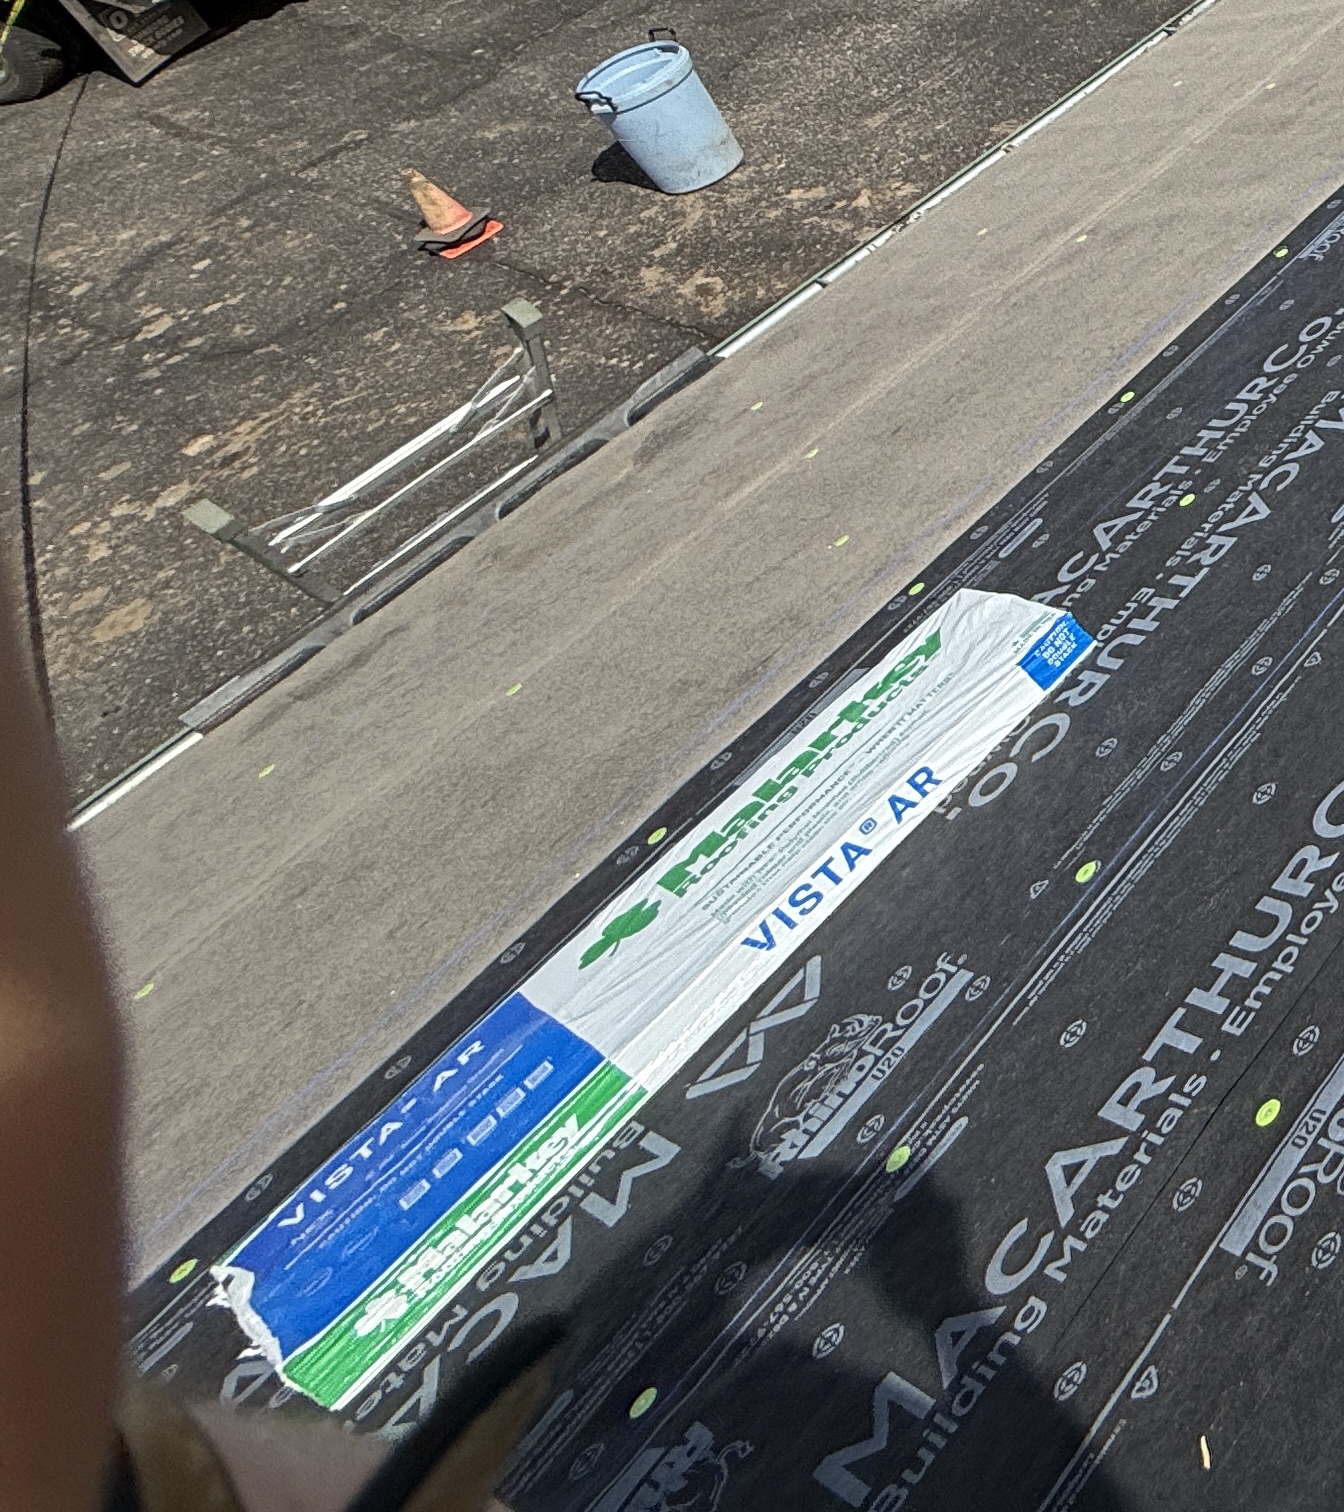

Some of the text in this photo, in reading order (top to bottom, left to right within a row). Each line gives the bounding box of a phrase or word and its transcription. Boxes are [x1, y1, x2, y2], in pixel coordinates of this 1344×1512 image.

[1099, 479, 1193, 572] Materials
[1204, 372, 1298, 464] Employee
[1163, 389, 1340, 571] Building Materials
[657, 629, 942, 894] Malarkey
[676, 663, 929, 898] Roofing Products
[886, 765, 943, 824] AR
[431, 1039, 485, 1093] AR
[1290, 1107, 1328, 1150] U20
[1040, 1070, 1208, 1283] Materials
